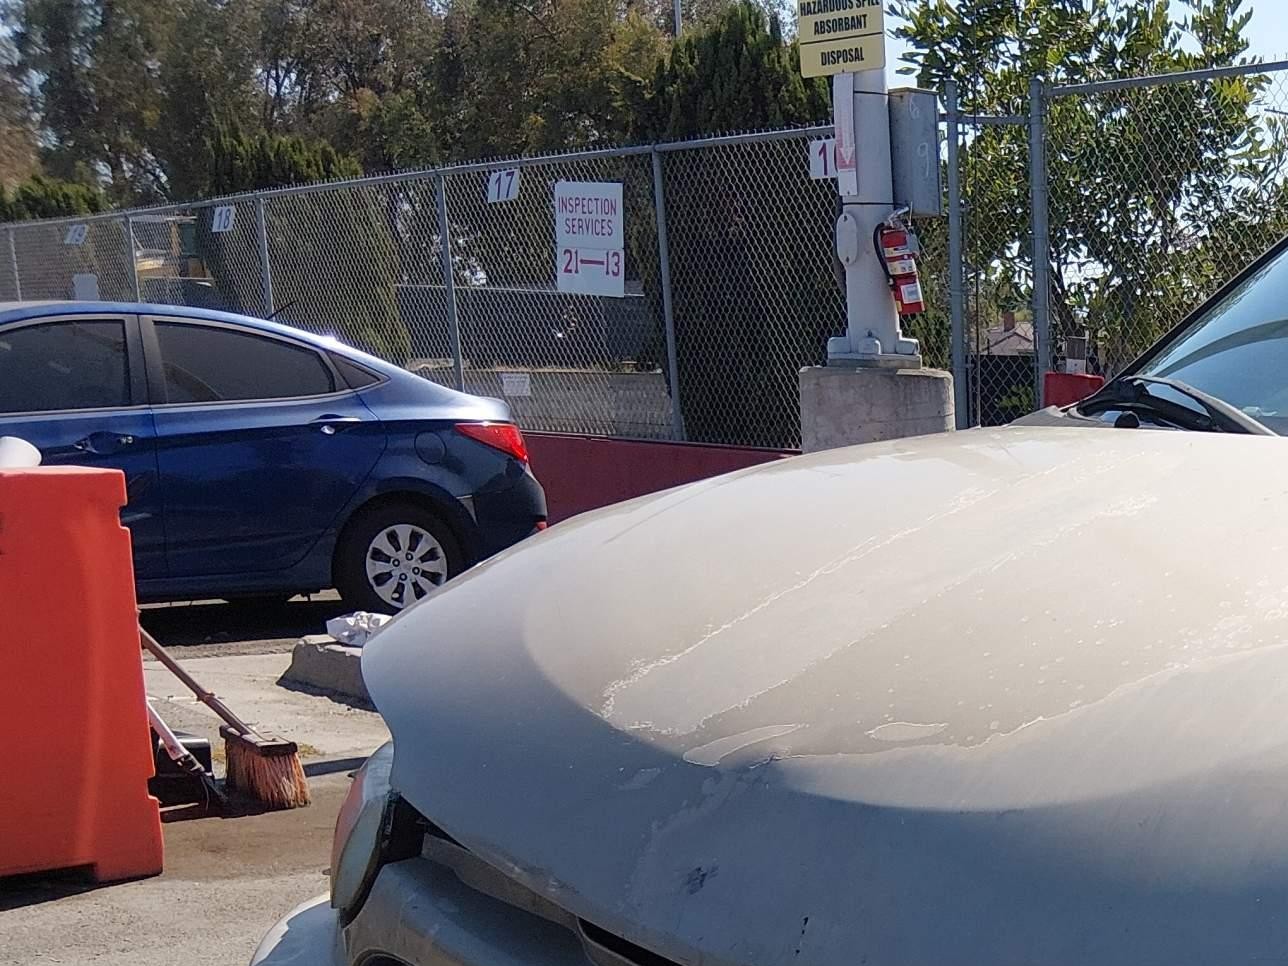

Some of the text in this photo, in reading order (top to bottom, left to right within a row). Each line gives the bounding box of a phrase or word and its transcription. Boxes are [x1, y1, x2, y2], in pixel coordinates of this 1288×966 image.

[800, 0, 854, 17] HAZARDOUS
[813, 14, 868, 36] ABSORBANT
[821, 46, 865, 66] DISPOSAL
[818, 141, 840, 177] 1
[494, 170, 516, 201] 17
[558, 196, 617, 217] INSPECTION
[217, 207, 232, 231] 18
[565, 218, 613, 237] SERVICES
